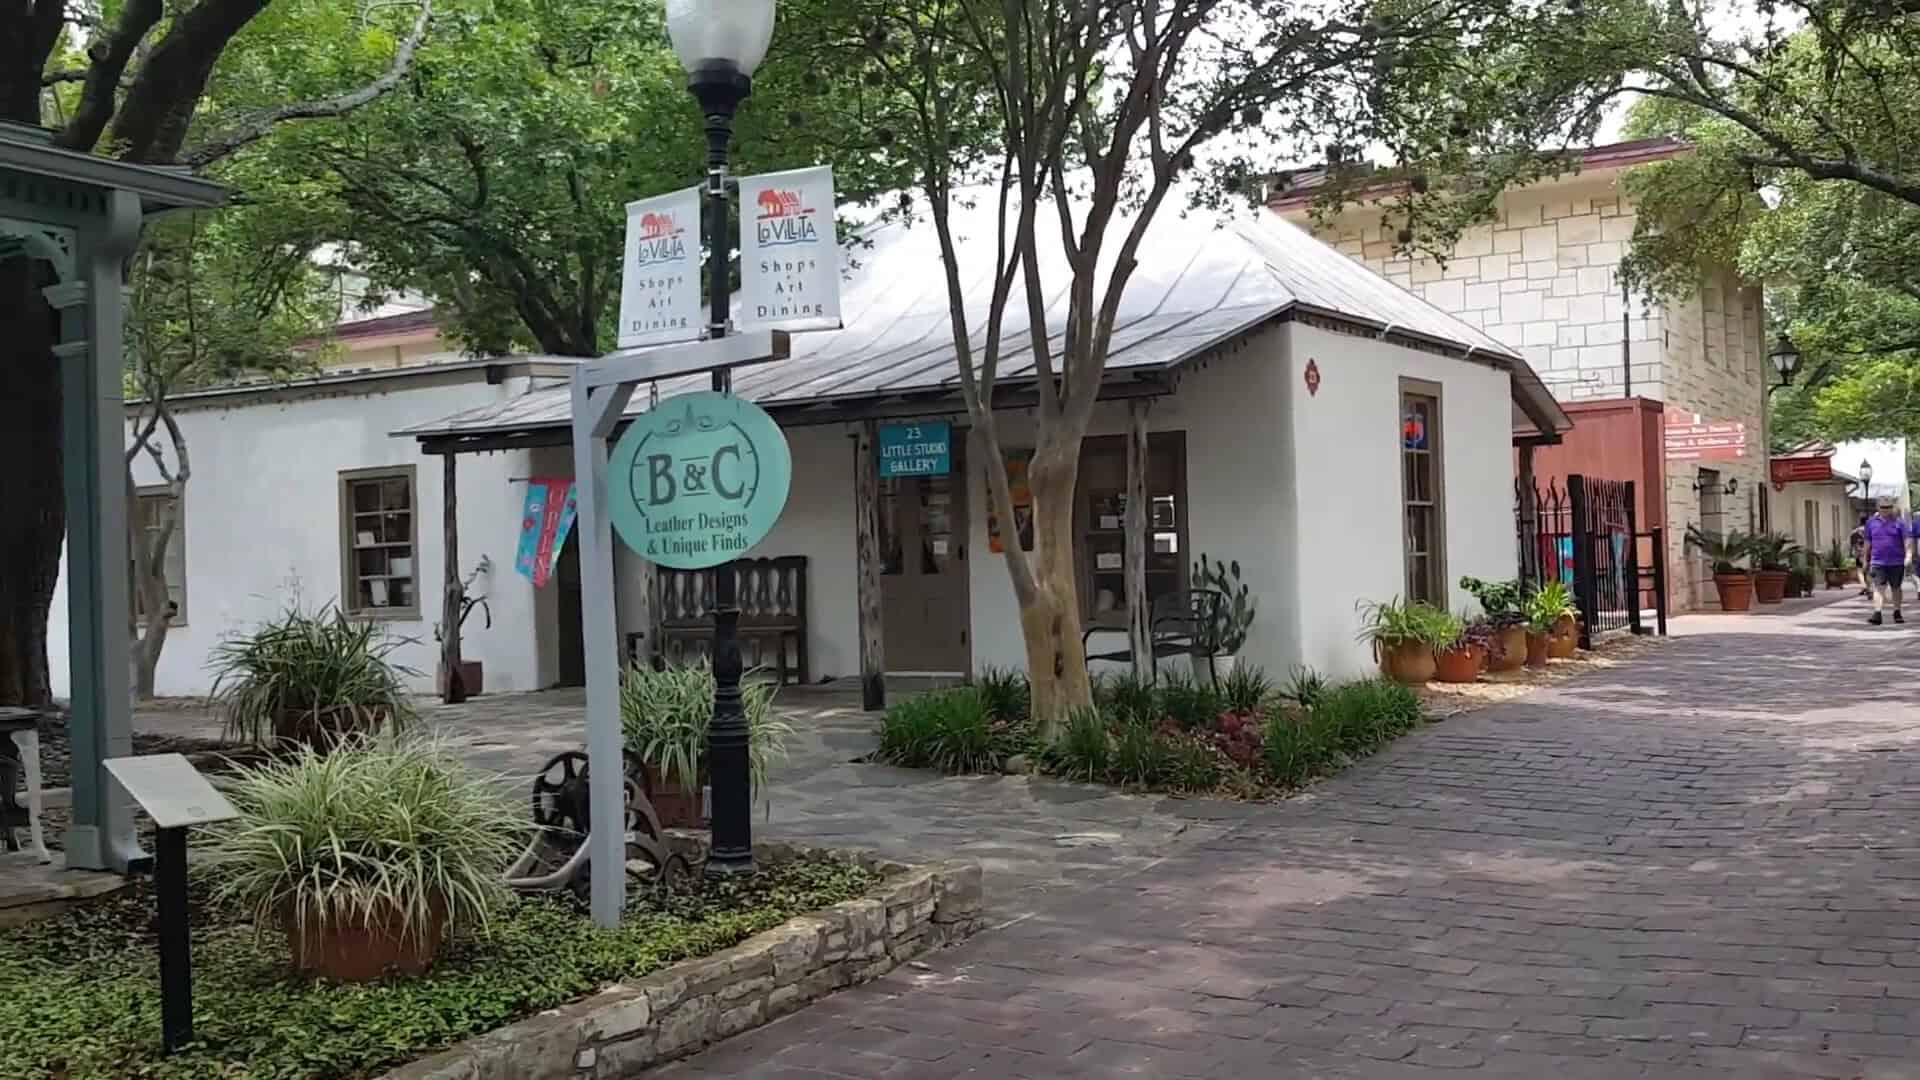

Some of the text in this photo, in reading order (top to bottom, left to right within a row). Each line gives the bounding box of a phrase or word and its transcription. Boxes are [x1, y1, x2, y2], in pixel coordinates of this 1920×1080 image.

[760, 259, 816, 275] Shops
[639, 275, 683, 291] Shops
[775, 280, 803, 295] Art
[647, 297, 672, 310] Art
[757, 303, 823, 319] Dining
[632, 317, 688, 332] Dining
[905, 426, 921, 440] 23
[881, 442, 946, 458] LITTLE STUDIO
[889, 458, 939, 473] GALLERY
[645, 511, 749, 535] Leather Designs
[647, 531, 749, 558] & Unique Finds
